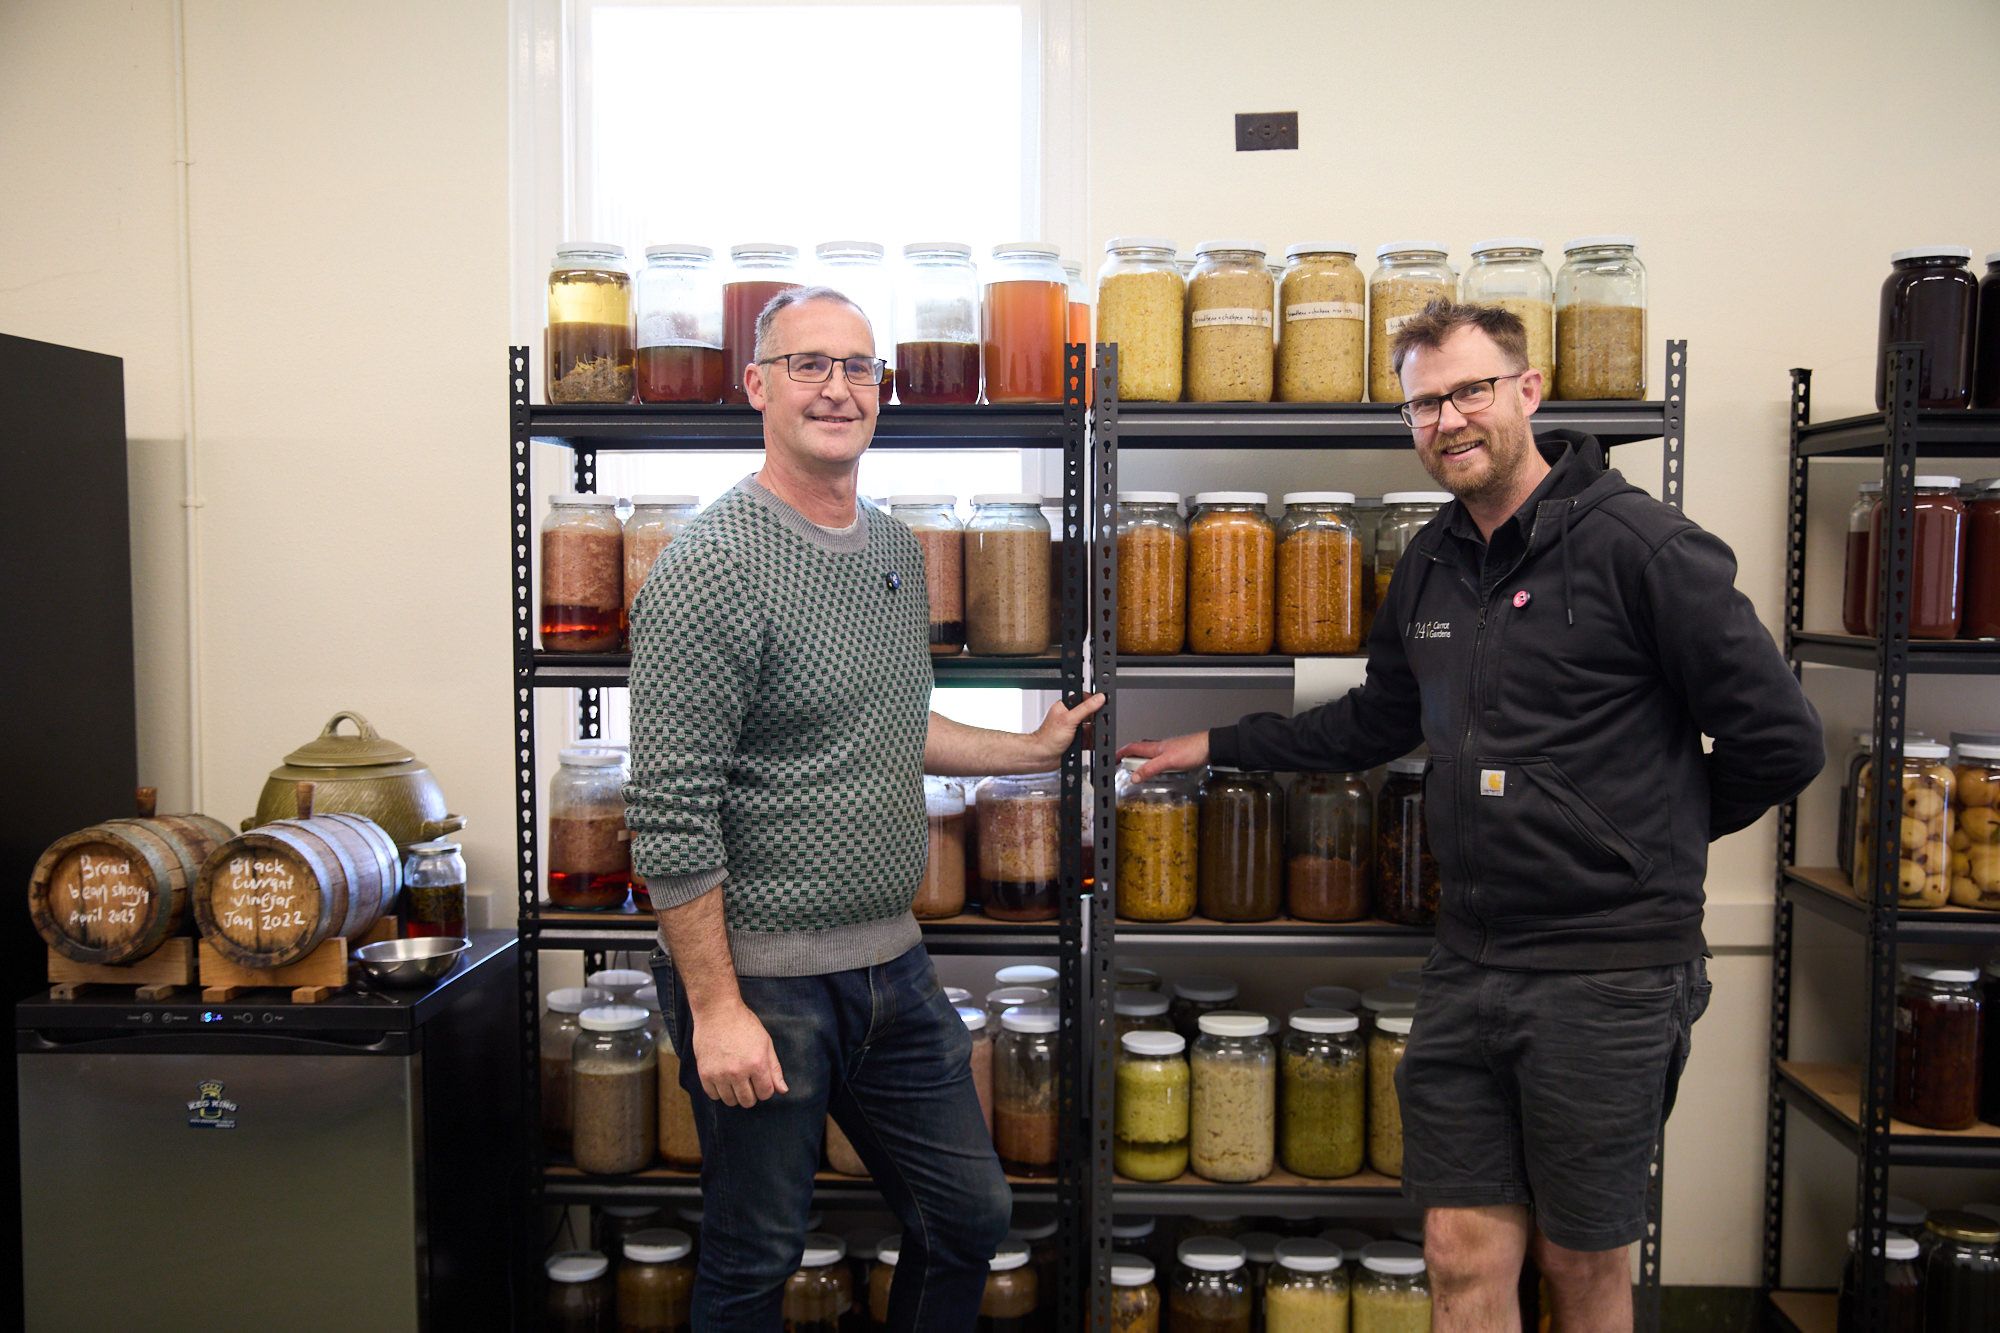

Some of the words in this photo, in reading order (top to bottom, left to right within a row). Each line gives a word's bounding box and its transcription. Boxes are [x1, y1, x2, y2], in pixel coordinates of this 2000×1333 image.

[1414, 621, 1426, 639] 24
[1430, 629, 1451, 638] Gardens
[1433, 621, 1450, 630] Carrot
[81, 855, 130, 879] Broad
[229, 857, 286, 876] Black
[68, 883, 108, 904] bean
[69, 906, 103, 926] April
[108, 907, 136, 924] 2025
[224, 909, 253, 930] Jan
[262, 910, 306, 930] 2022
